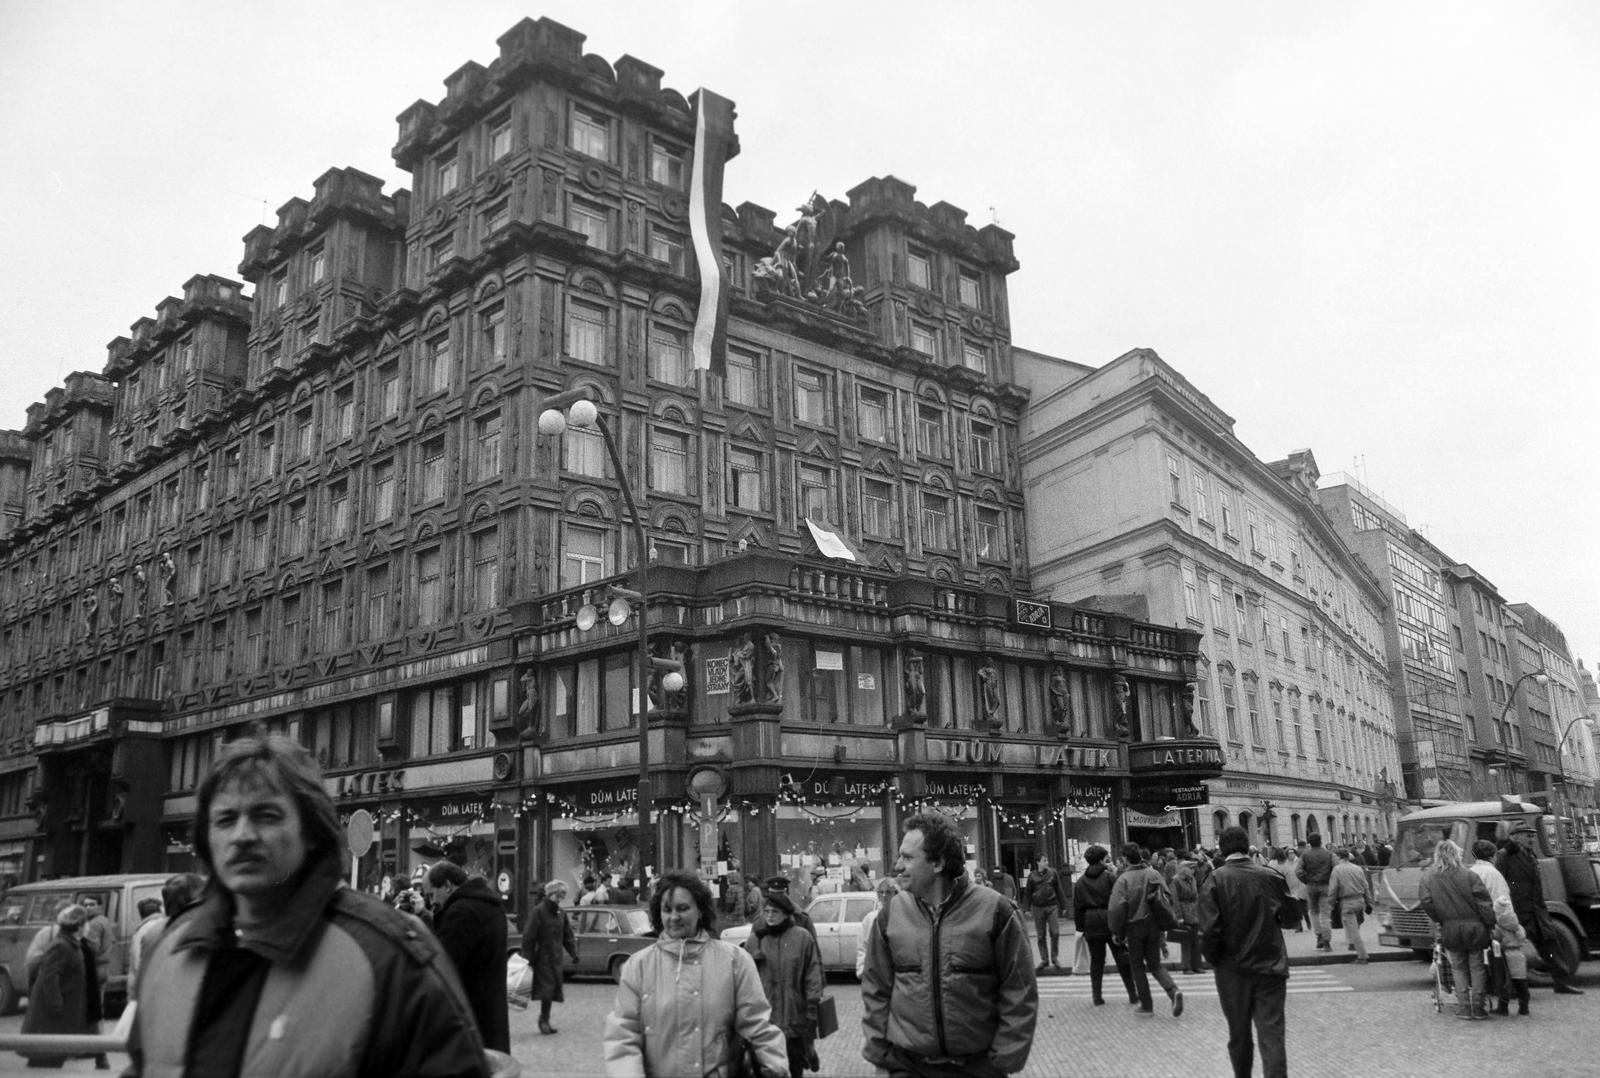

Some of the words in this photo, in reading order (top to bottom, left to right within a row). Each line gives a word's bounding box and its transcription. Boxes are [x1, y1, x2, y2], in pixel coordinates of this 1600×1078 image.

[1152, 748, 1222, 765] LATERNA
[591, 789, 613, 804] DŮM
[616, 787, 638, 802] LÁTE
[1176, 792, 1202, 802] ADRIA
